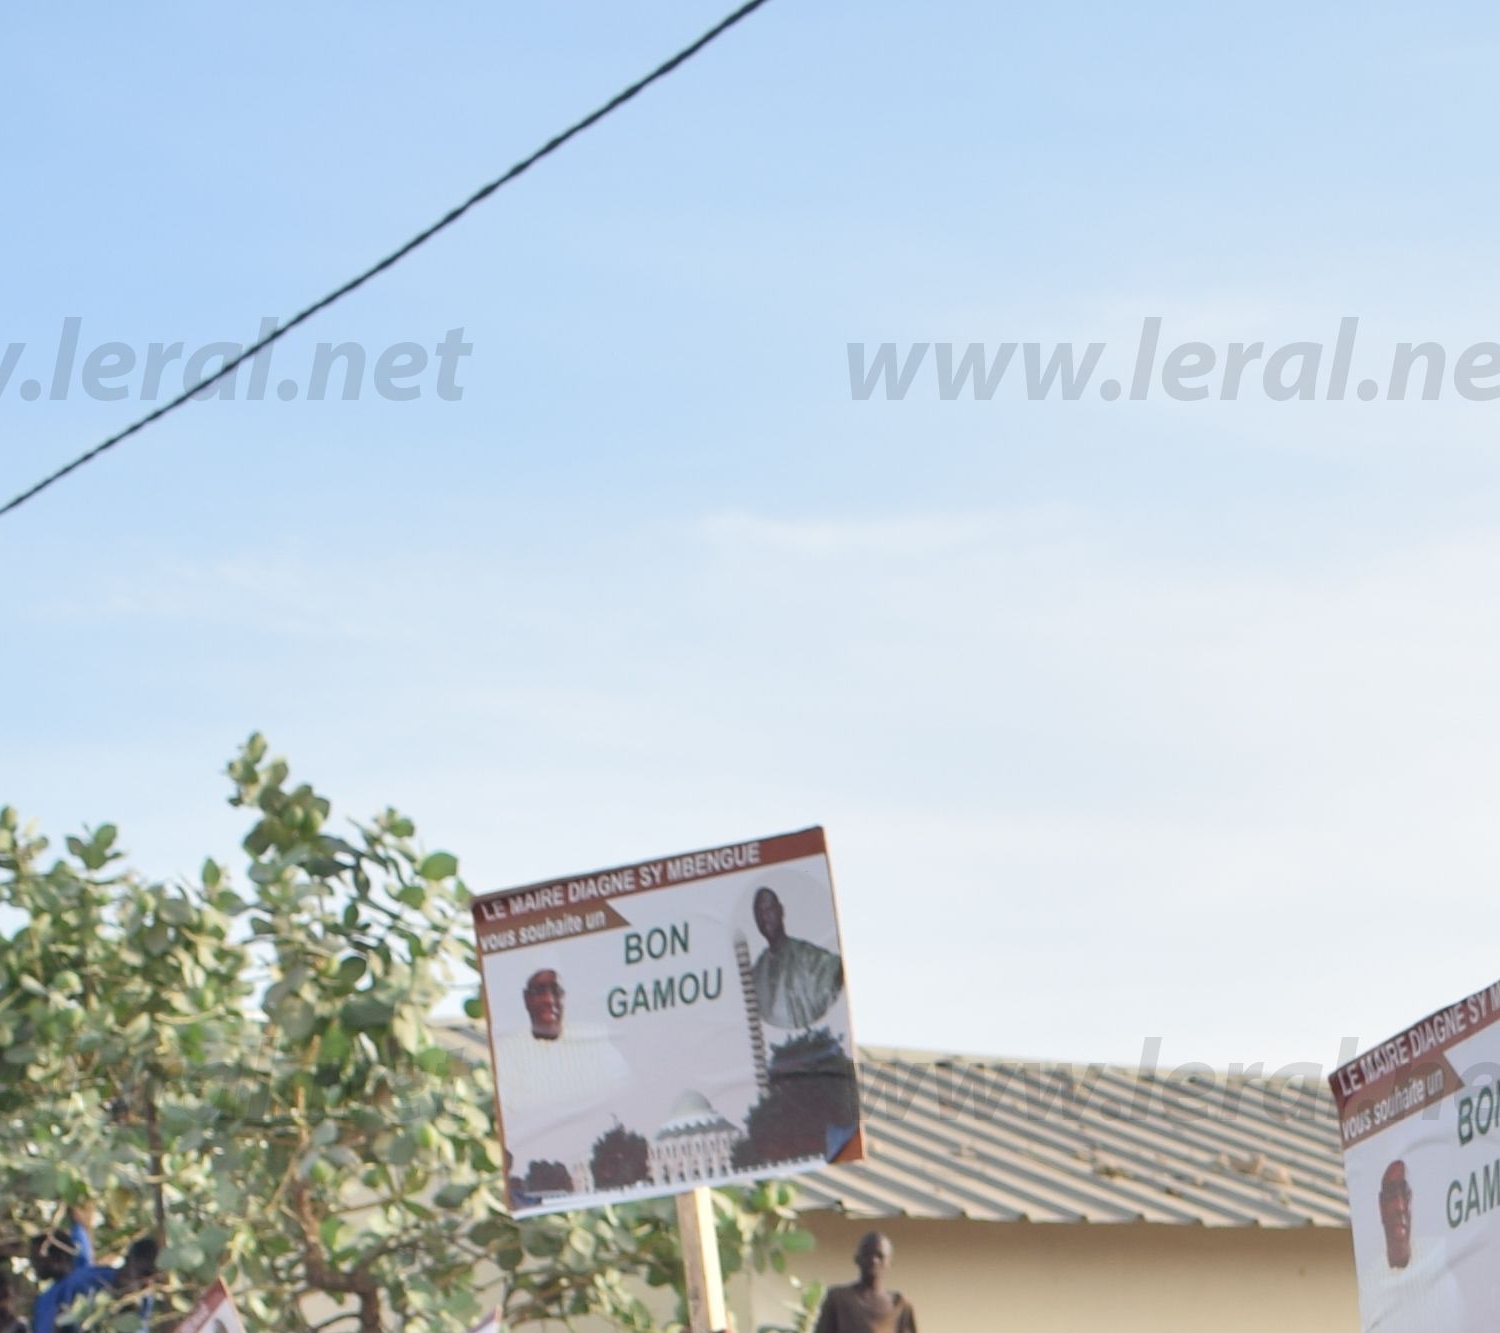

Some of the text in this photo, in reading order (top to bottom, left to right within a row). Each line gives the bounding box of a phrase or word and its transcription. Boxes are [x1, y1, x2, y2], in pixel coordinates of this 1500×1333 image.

[482, 842, 760, 921] LE MAIRE DIAGNE SY MBENGUE
[479, 910, 606, 951] vous souhaite un
[624, 922, 689, 965] BON
[607, 967, 722, 1018] GAMOU
[1338, 1065, 1362, 1096] LE
[1360, 1035, 1409, 1085] MAIRE
[1409, 1001, 1466, 1057] DIAGNE
[1466, 991, 1487, 1024] SY
[1342, 1068, 1444, 1141] vous souhaite un
